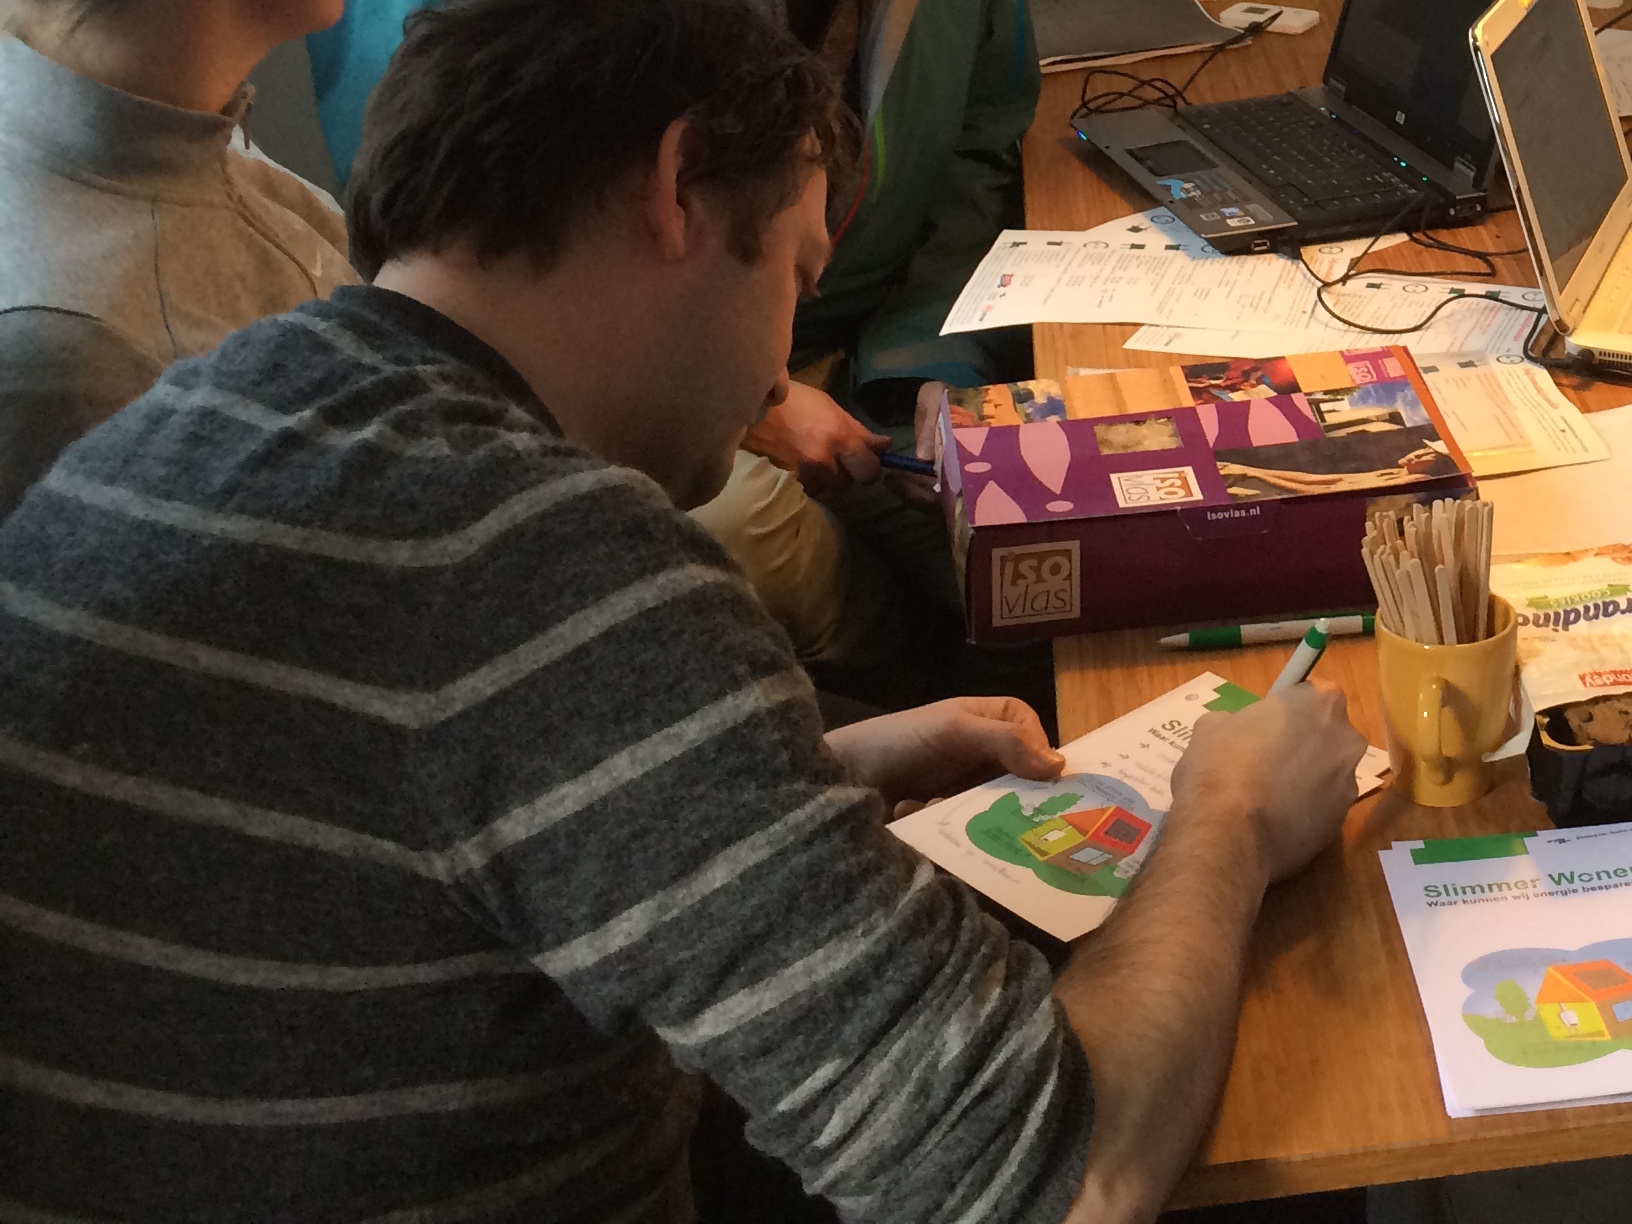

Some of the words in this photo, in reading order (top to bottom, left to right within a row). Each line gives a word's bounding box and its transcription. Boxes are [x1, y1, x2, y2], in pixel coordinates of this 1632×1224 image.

[1004, 584, 1067, 614] vlas
[1550, 589, 1610, 607] COOKIES
[1423, 878, 1540, 898] Slimmer
[1426, 899, 1458, 908] Waar
[1461, 894, 1508, 905] kunnen
[1512, 892, 1529, 901] wij
[1533, 886, 1578, 898] energie
